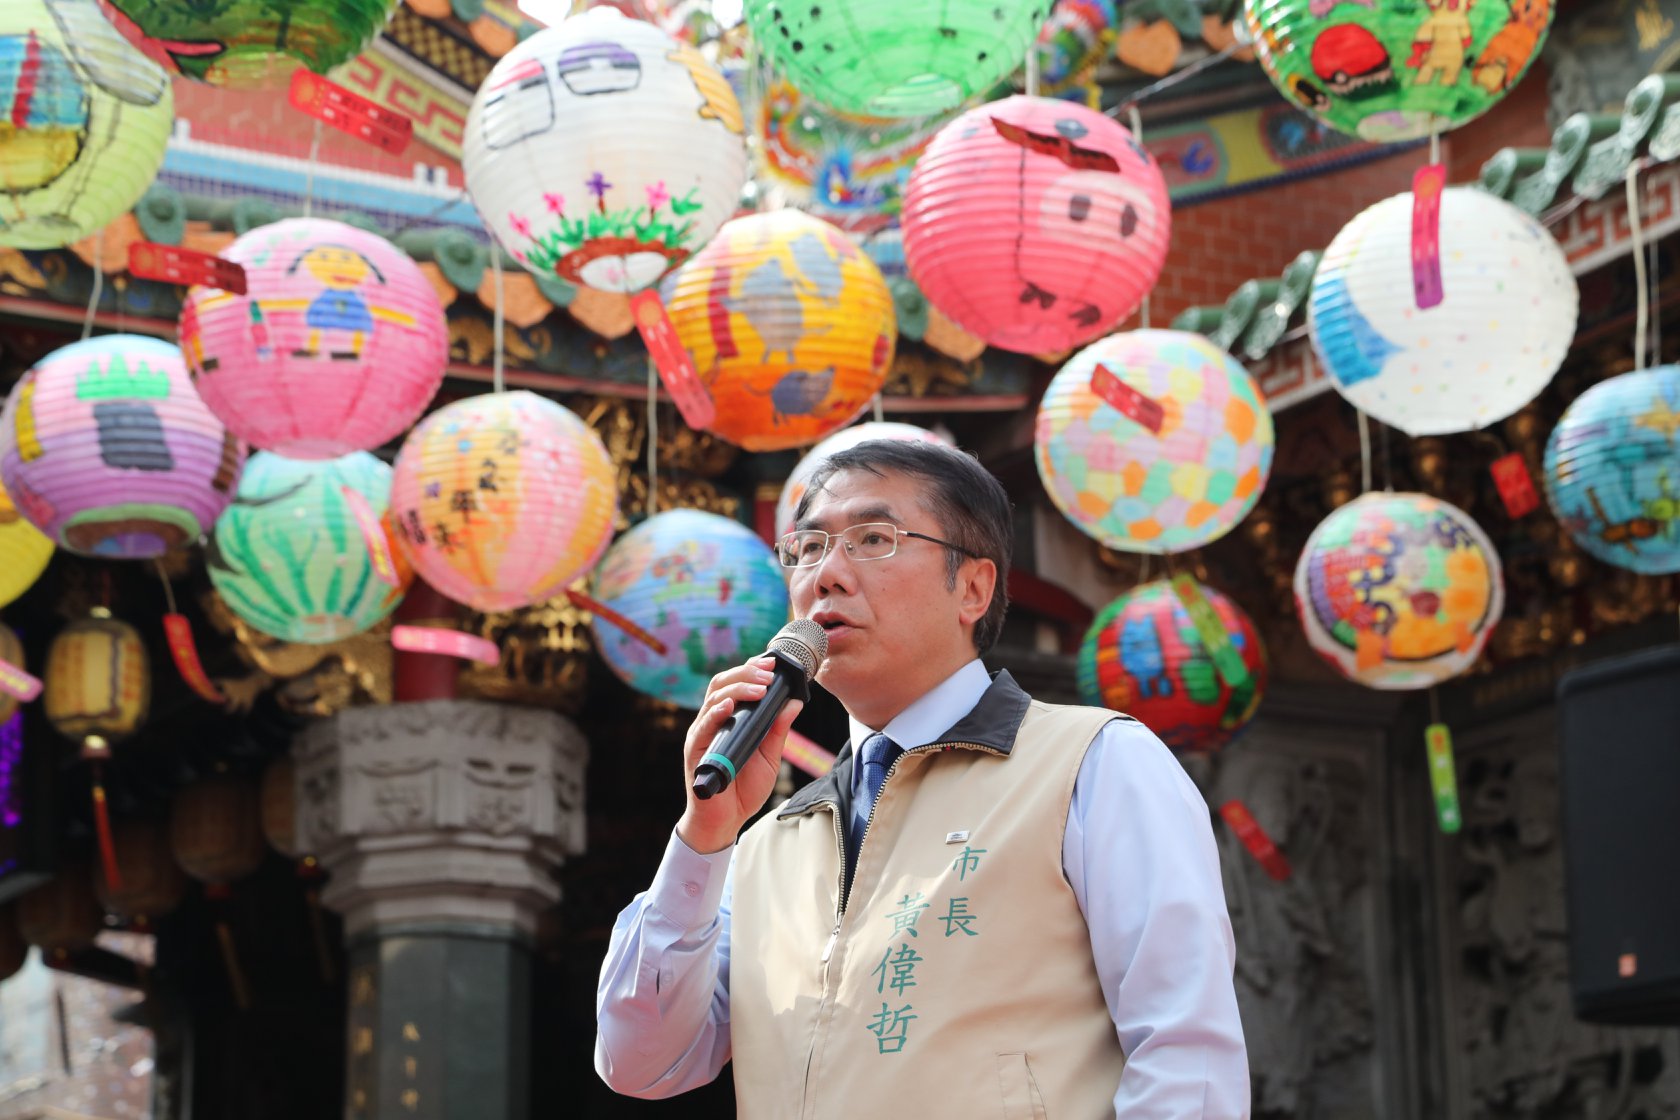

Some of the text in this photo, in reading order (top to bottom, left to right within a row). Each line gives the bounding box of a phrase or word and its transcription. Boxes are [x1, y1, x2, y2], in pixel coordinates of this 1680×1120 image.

[938, 846, 987, 937] 市長
[866, 892, 930, 1055] 黃偉哲
